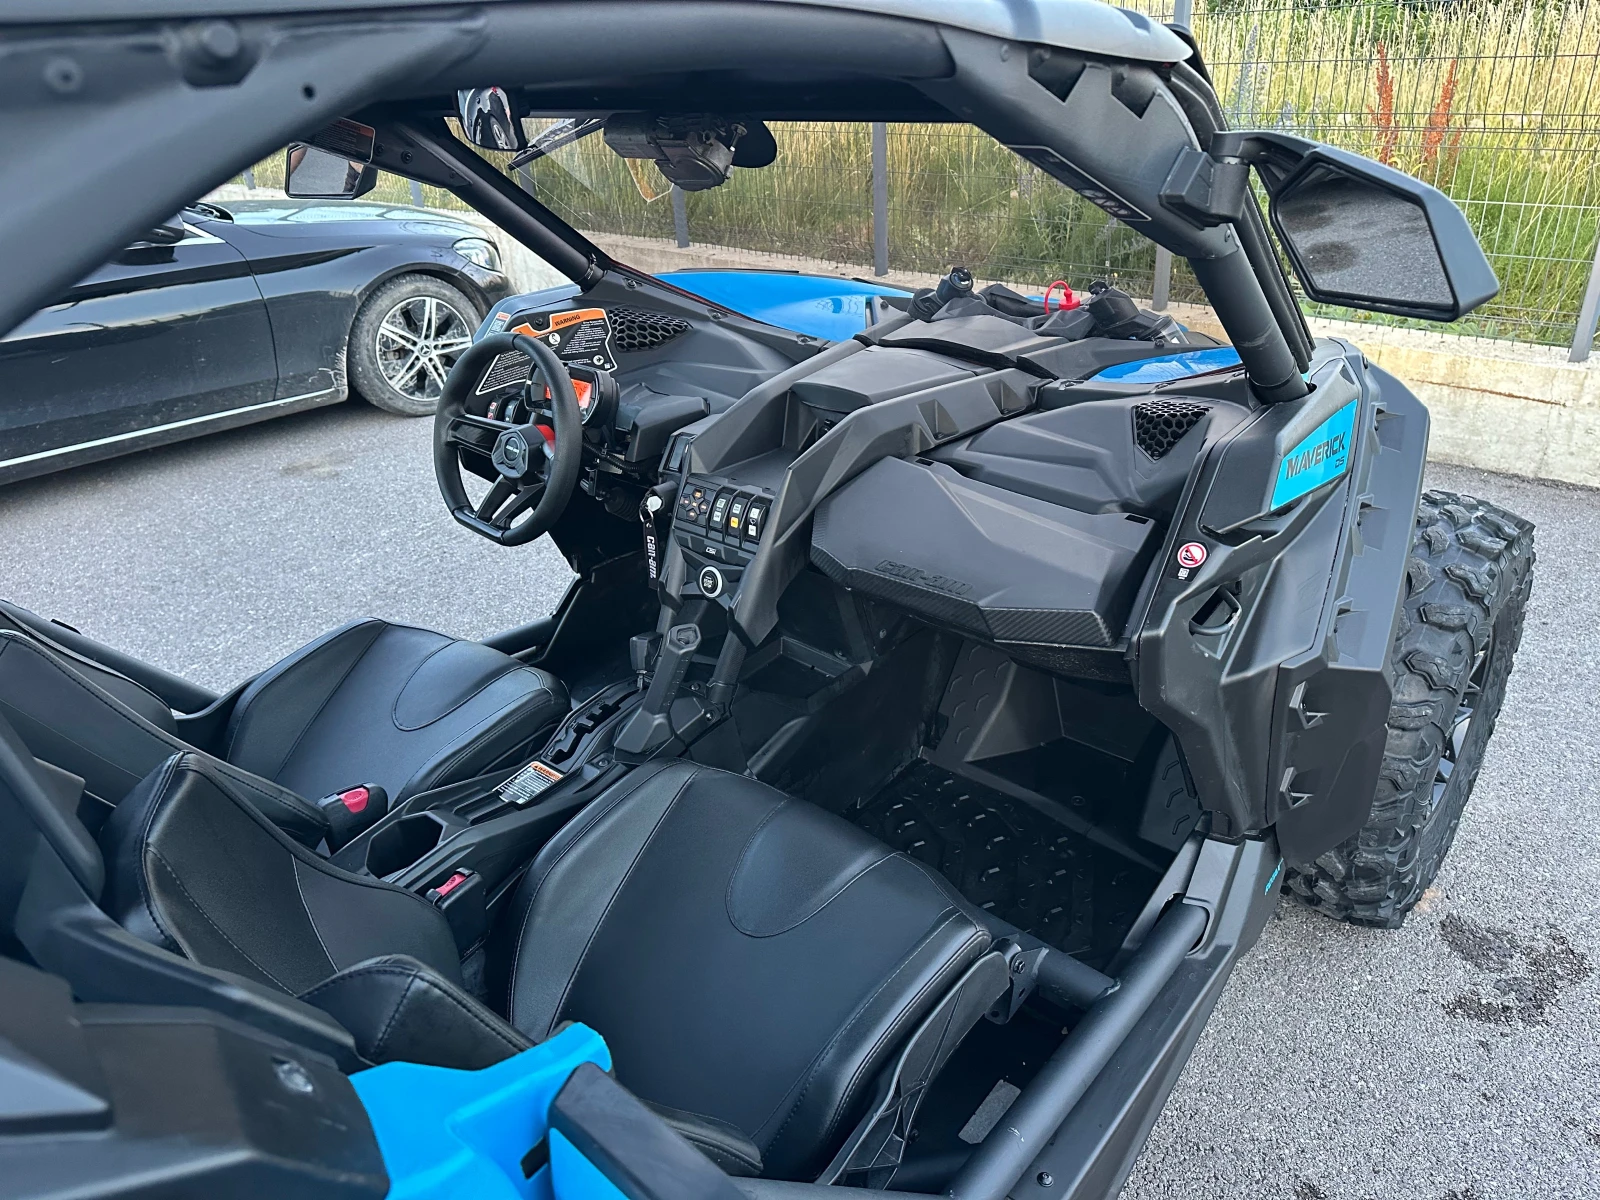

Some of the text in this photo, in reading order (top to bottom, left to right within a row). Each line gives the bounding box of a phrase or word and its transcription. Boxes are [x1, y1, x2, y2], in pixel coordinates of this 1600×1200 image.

[554, 314, 581, 327] WARNING
[1285, 432, 1346, 480] MAVERICK
[1334, 456, 1345, 468] DS
